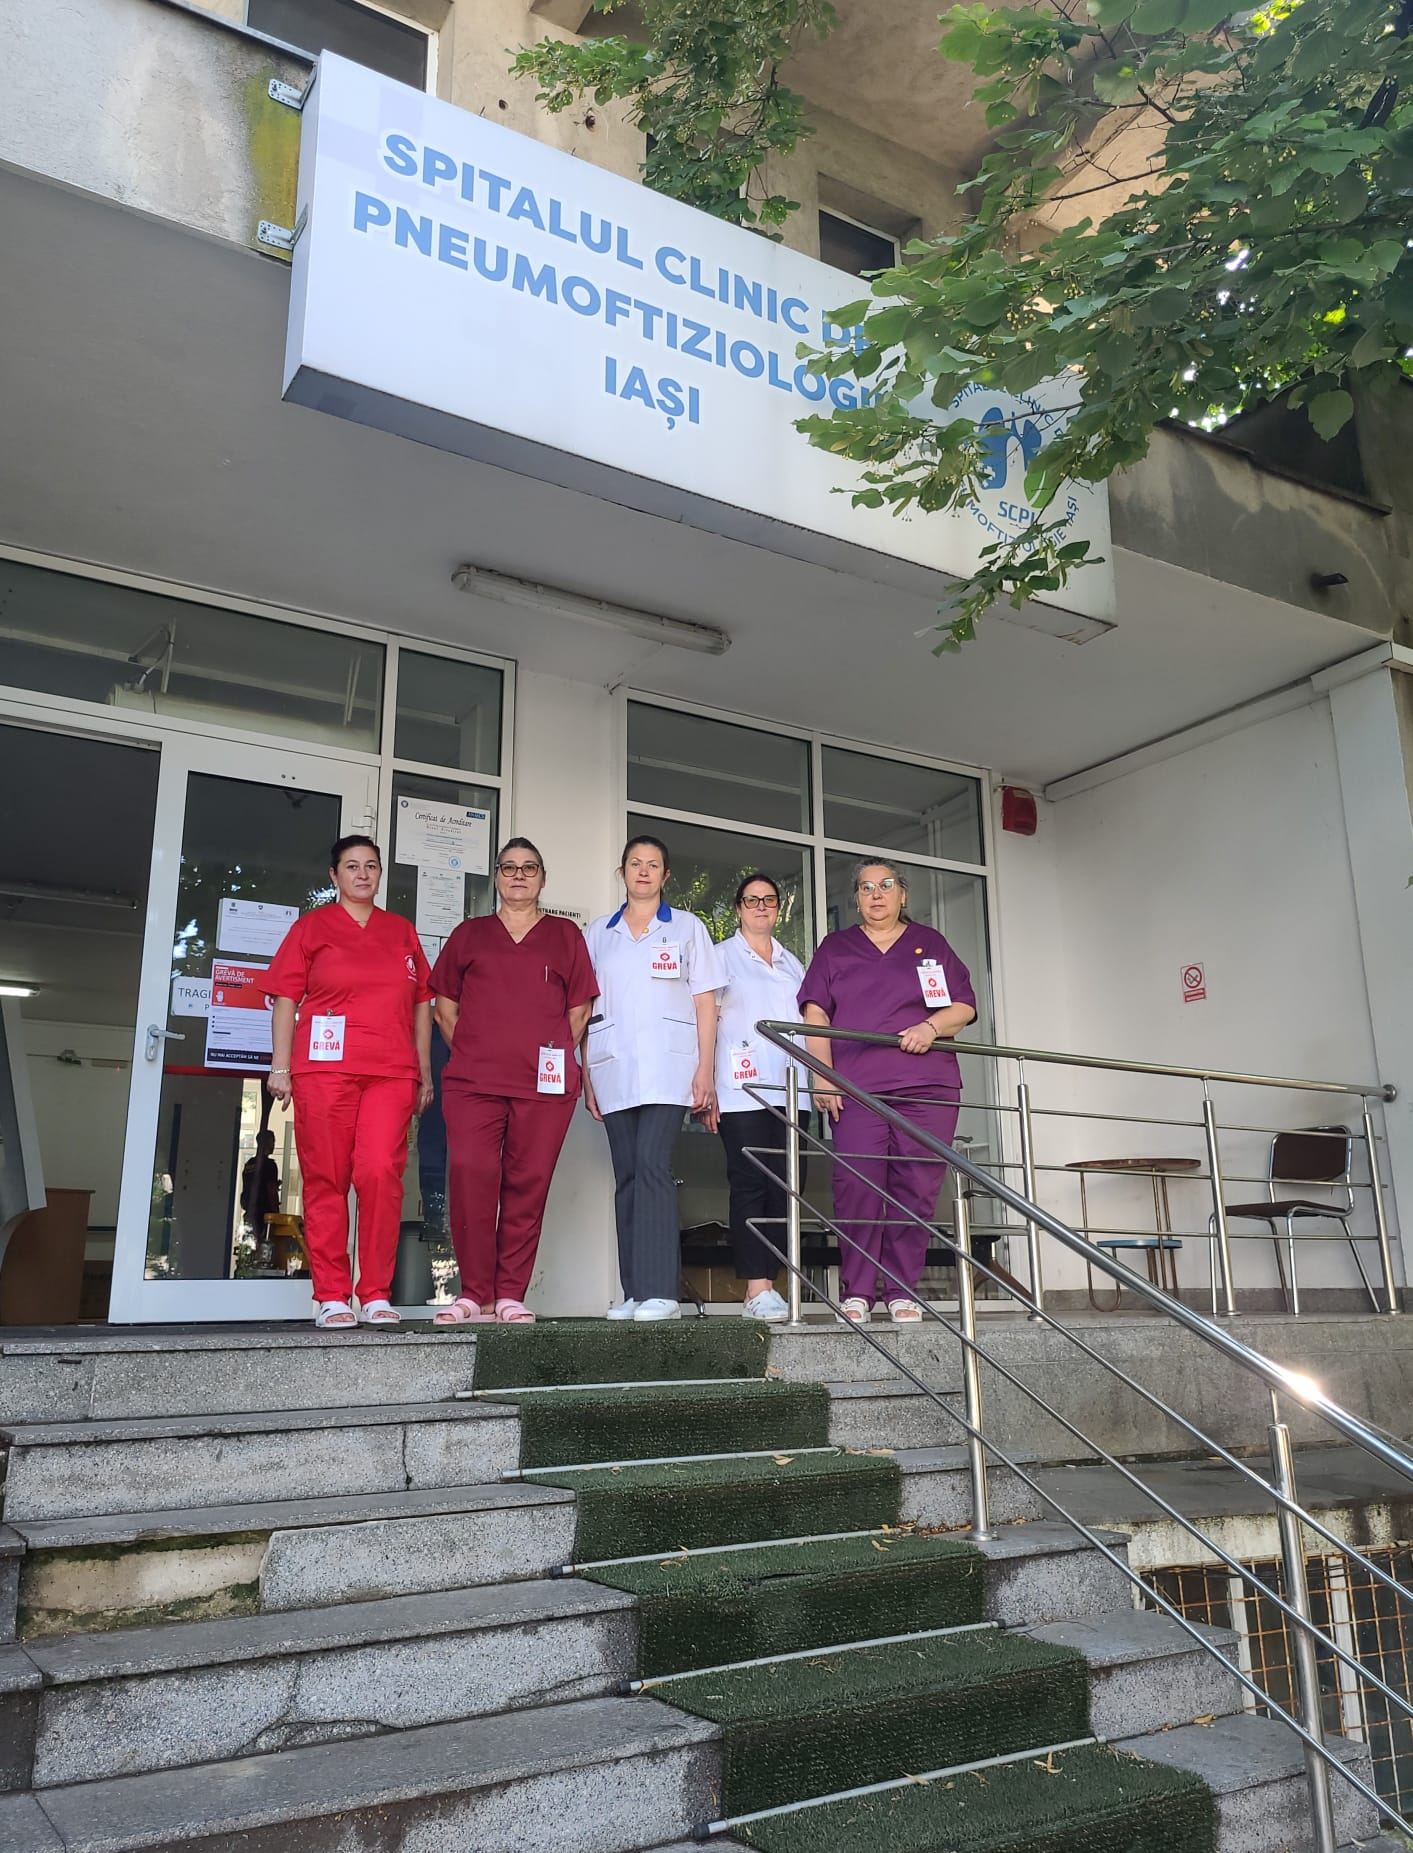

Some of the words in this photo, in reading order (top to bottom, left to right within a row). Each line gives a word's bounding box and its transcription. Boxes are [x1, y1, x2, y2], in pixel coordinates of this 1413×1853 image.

[353, 190, 882, 411] PNEUMOFTIZIOLOGI
[383, 133, 644, 270] SPITALUL
[655, 246, 810, 334] CLINIC
[604, 355, 700, 430] IAȘI
[997, 500, 1036, 527] SCPI
